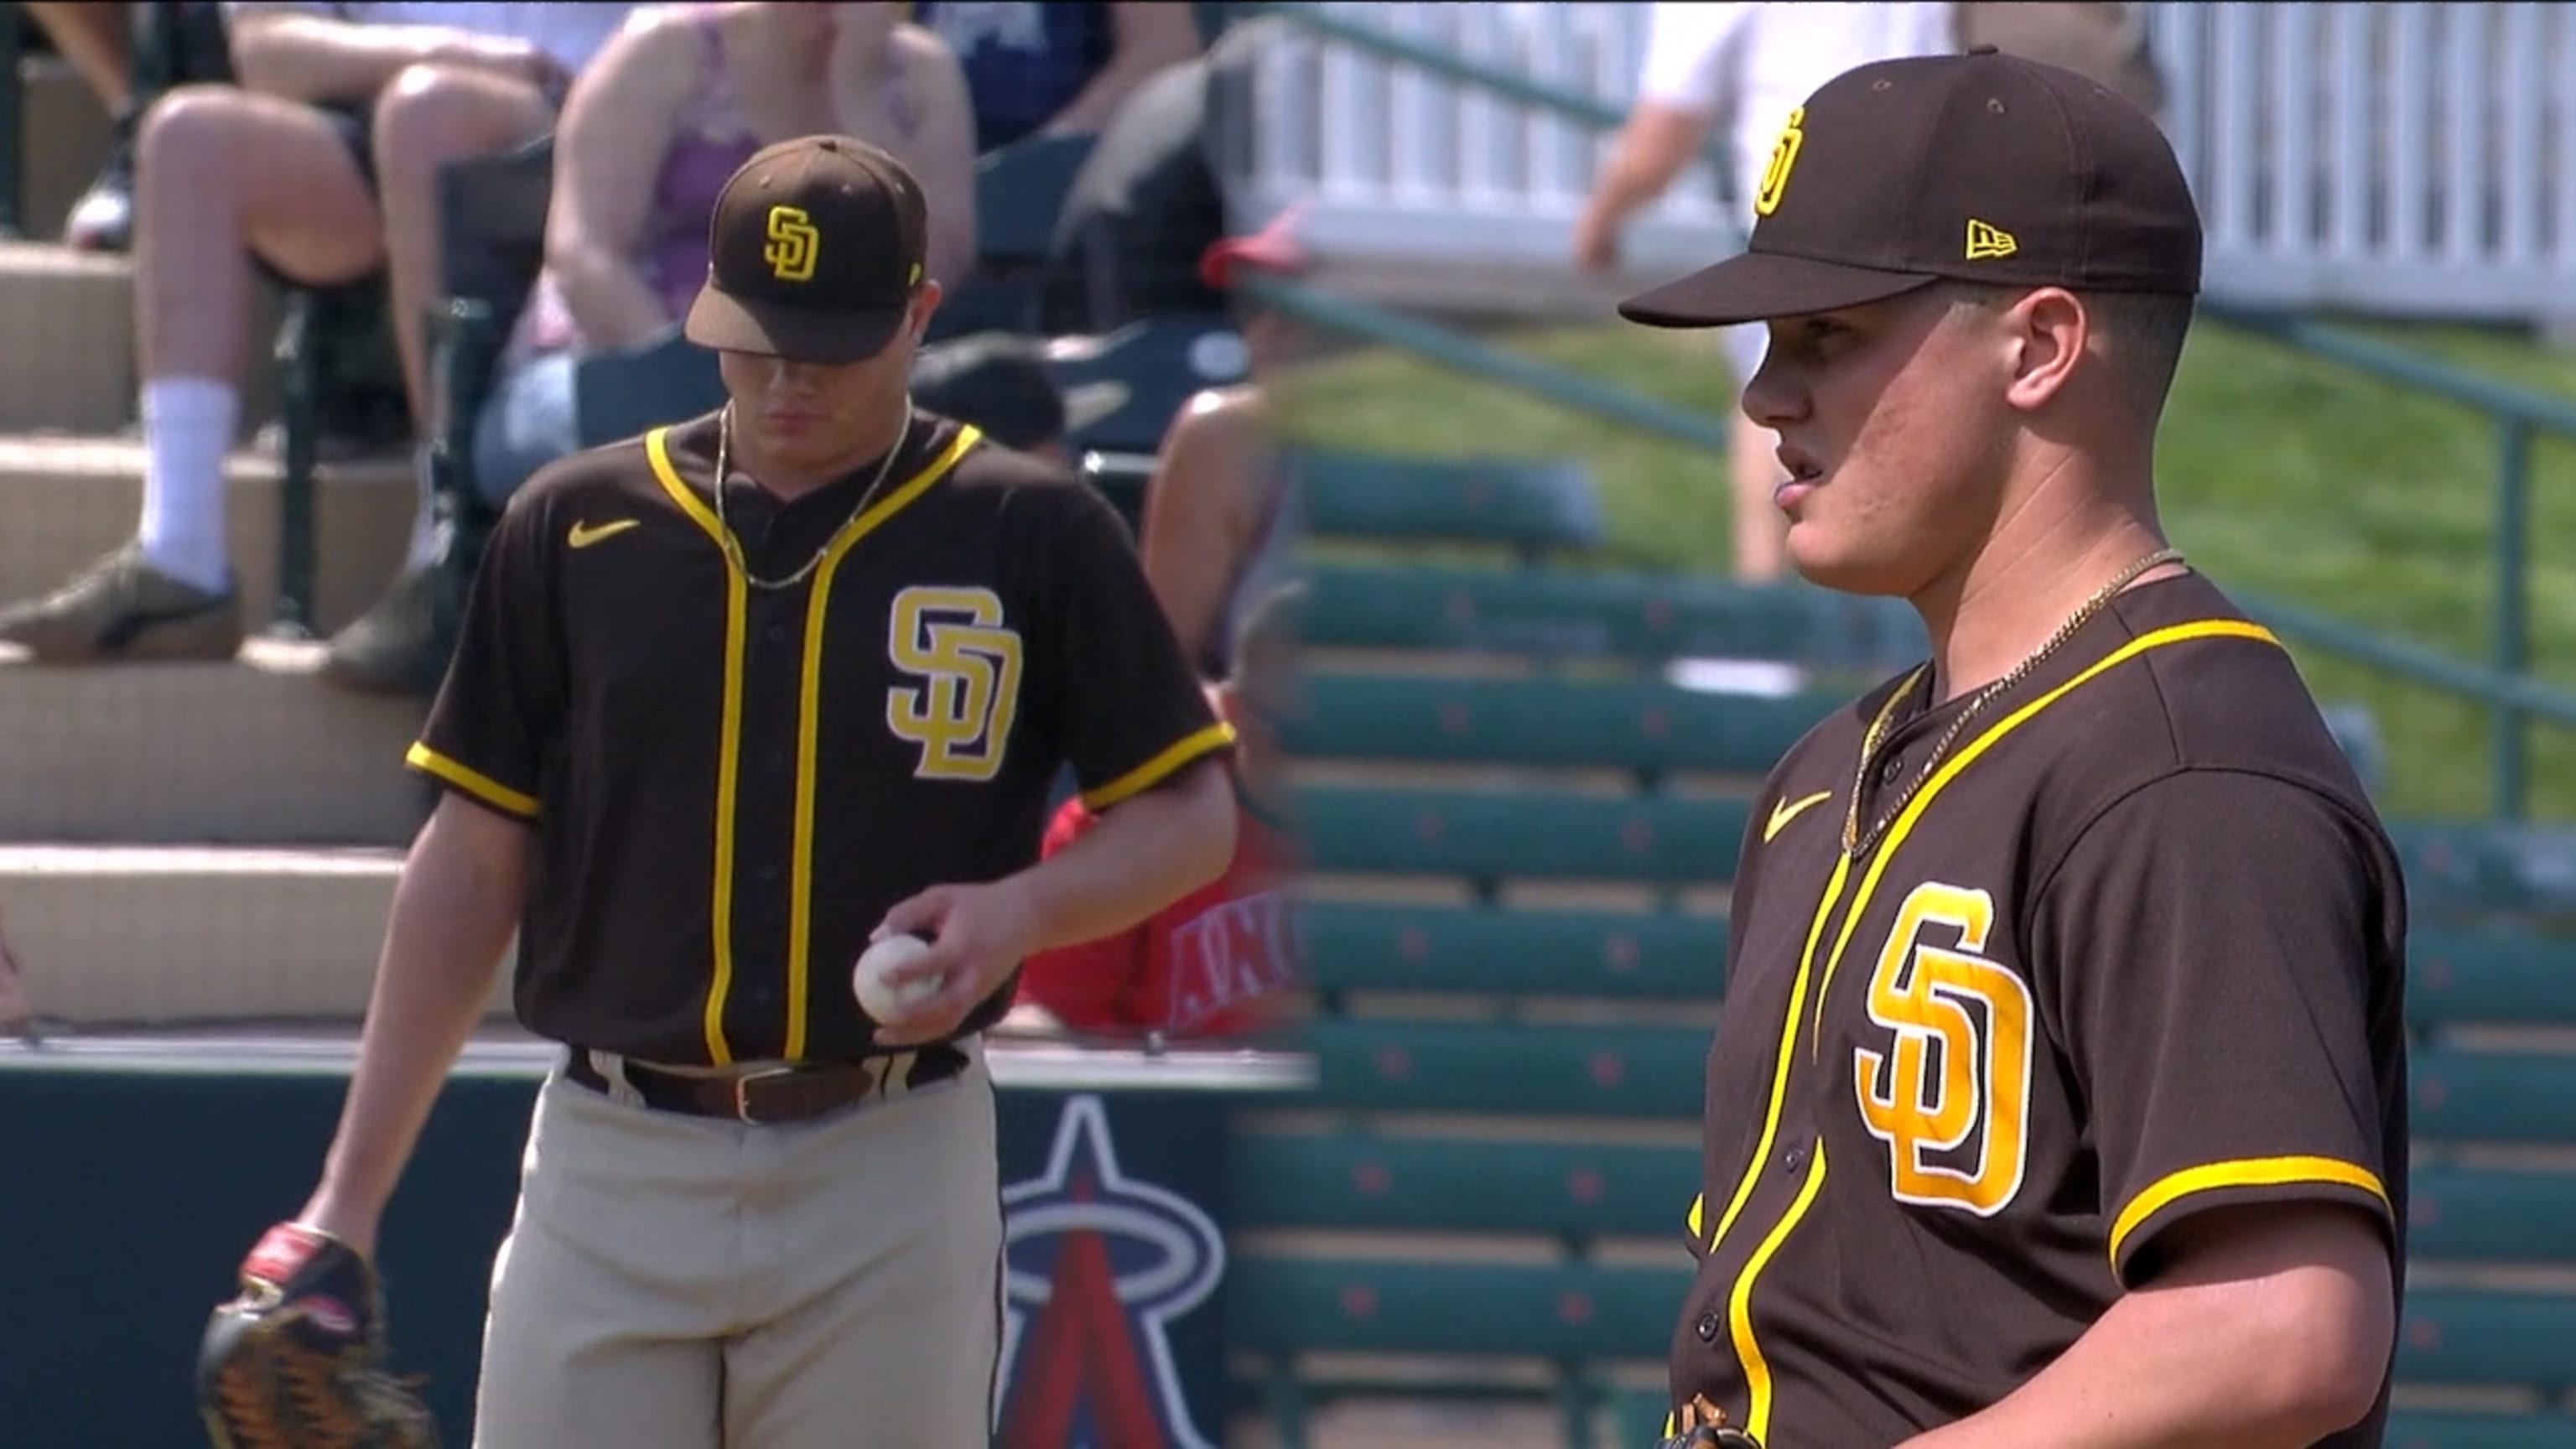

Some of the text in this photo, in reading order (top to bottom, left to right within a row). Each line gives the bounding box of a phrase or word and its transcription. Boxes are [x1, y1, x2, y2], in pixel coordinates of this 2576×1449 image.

[764, 206, 819, 281] SD
[886, 585, 1023, 782] SD
[1855, 881, 2036, 1217] SD
